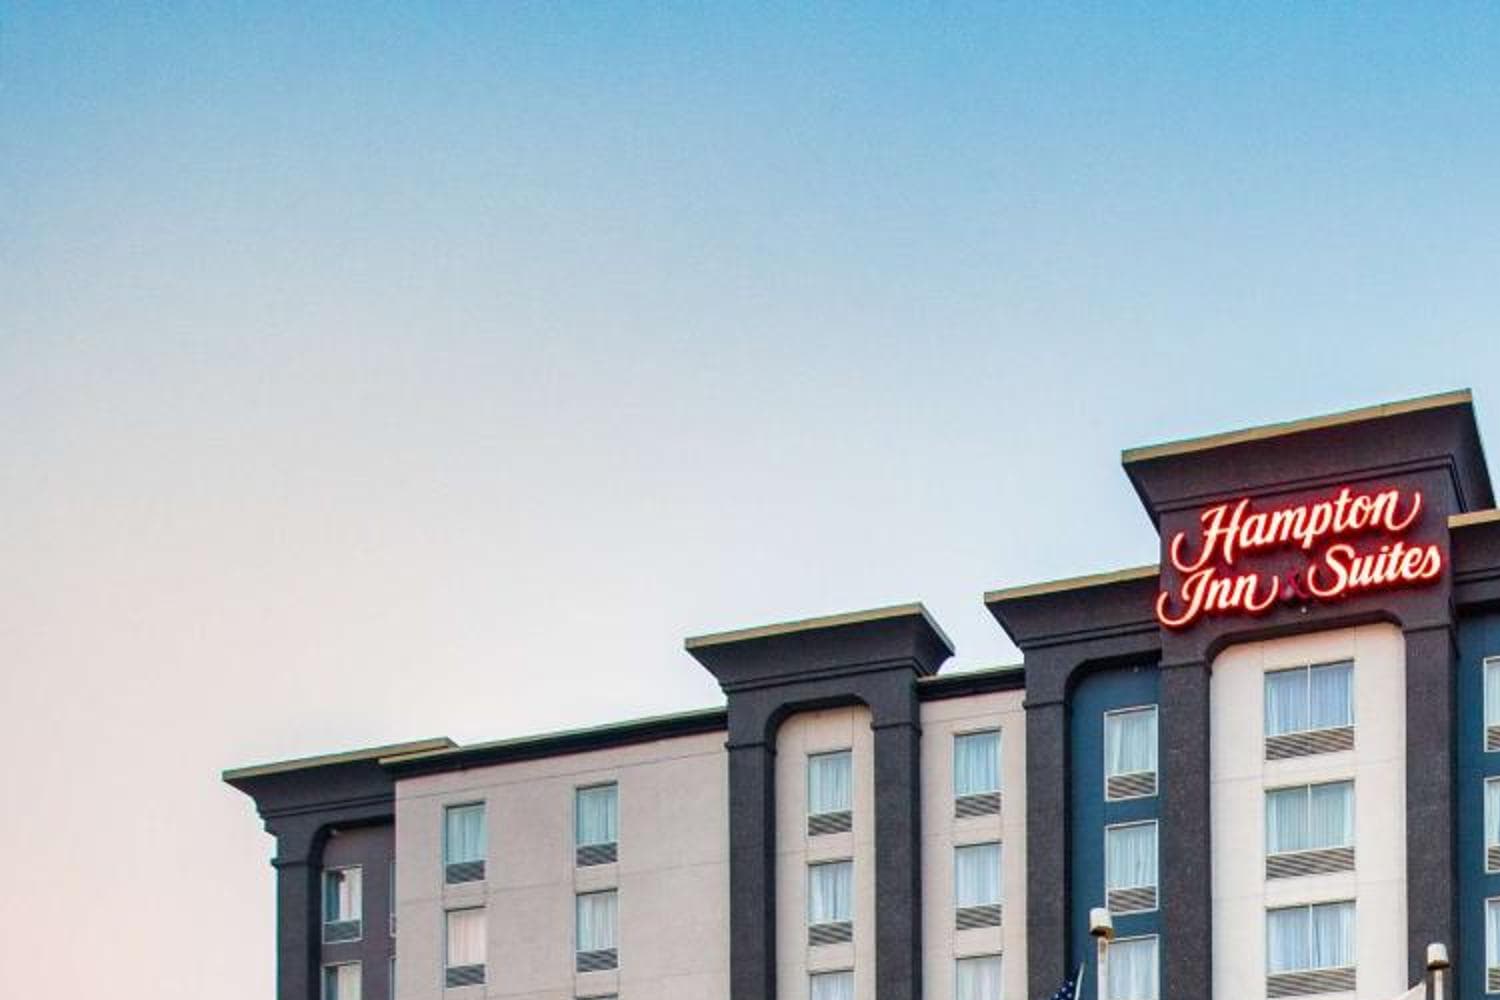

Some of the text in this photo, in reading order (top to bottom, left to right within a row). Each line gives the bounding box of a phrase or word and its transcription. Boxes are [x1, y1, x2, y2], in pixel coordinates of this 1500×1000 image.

[1171, 487, 1421, 572] Hampton
[1157, 567, 1279, 625] Inn
[1307, 541, 1441, 597] Suites
